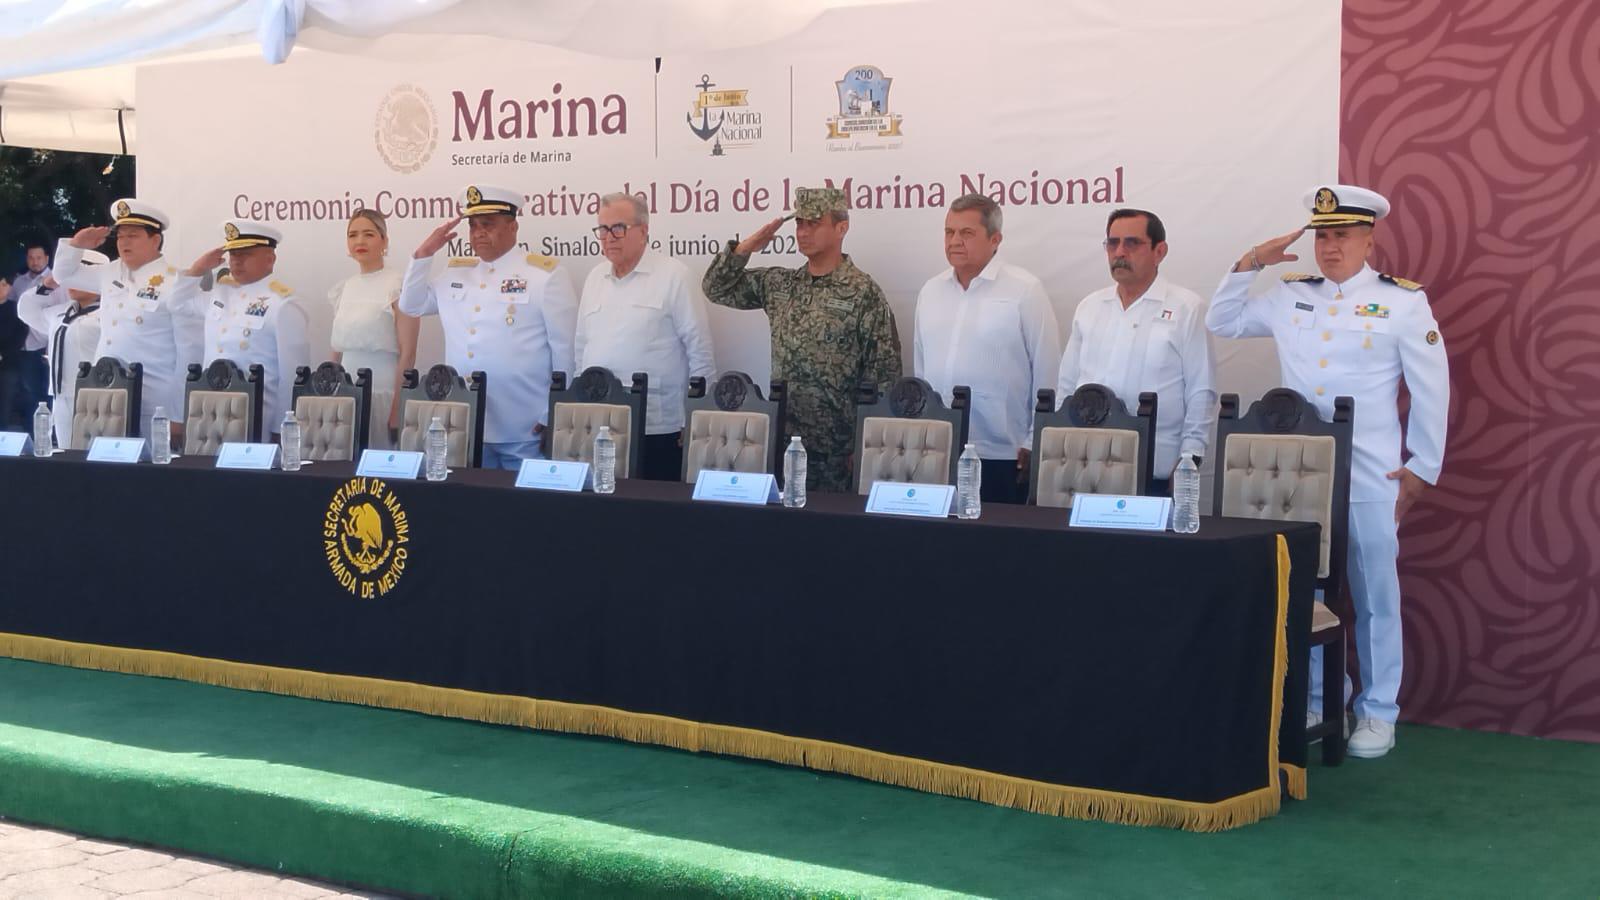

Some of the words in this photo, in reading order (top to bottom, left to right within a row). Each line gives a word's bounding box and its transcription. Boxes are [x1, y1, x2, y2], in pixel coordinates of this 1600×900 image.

[854, 69, 874, 81] 200
[452, 82, 627, 142] Marina
[727, 110, 761, 125] Marina
[721, 126, 762, 140] Nacional
[451, 151, 510, 166] Secretaría
[512, 151, 527, 164] de
[530, 150, 572, 163] Marina
[670, 179, 719, 213] Día
[732, 178, 770, 212] de
[960, 166, 1124, 206] Nacional
[541, 236, 605, 257] Sinalo
[669, 234, 720, 257] junio
[324, 477, 367, 538] SECRETARIA
[370, 478, 386, 499] DE
[384, 491, 409, 544] MARINA
[324, 540, 357, 595] ARMADA
[361, 581, 375, 599] DE
[378, 547, 409, 597] MEXICO
